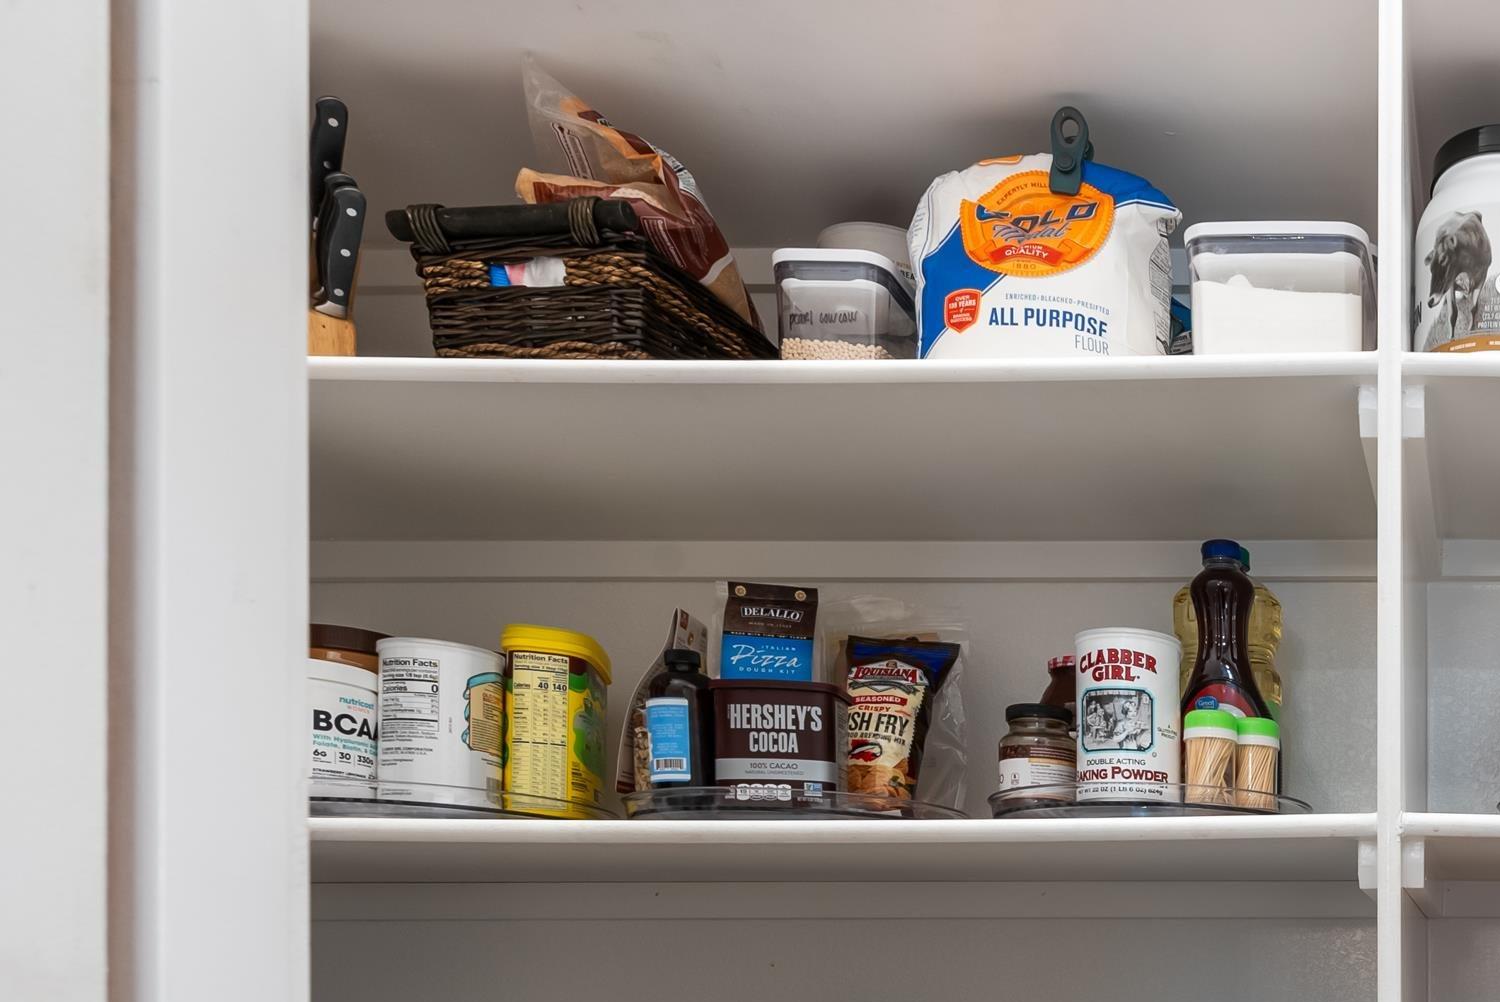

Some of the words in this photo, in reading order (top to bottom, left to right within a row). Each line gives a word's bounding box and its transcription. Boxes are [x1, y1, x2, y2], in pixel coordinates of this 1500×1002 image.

[1004, 248, 1049, 259] QUALITY
[988, 307, 1019, 327] ALL
[1024, 307, 1108, 338] PURPOSE
[1075, 334, 1110, 356] FLOUR
[743, 607, 800, 621] DELALLO
[514, 653, 546, 663] Nutrition
[547, 656, 568, 665] Facts
[730, 643, 802, 668] Pizza
[1079, 648, 1158, 674] CLABBER
[382, 658, 410, 667] Nutrition
[413, 659, 438, 668] Facts
[853, 666, 918, 684] LOUISIANA
[1092, 664, 1136, 682] GIRL
[382, 684, 408, 692] Calories
[431, 684, 439, 693] 0
[538, 681, 549, 690] 40
[552, 682, 567, 691] 140
[338, 696, 374, 711] nutricost
[855, 695, 901, 703] SEASONED
[858, 705, 891, 713] CRISPY
[730, 703, 823, 732] HERSHEY'S
[874, 711, 909, 737] FRY
[749, 731, 799, 754] COCOA
[338, 751, 351, 761] 30
[1086, 758, 1114, 767] DOUBLE
[1116, 757, 1146, 766] ACTING
[749, 762, 768, 770] 100%
[769, 762, 799, 770] CACAO
[1111, 766, 1169, 784] POWDER
